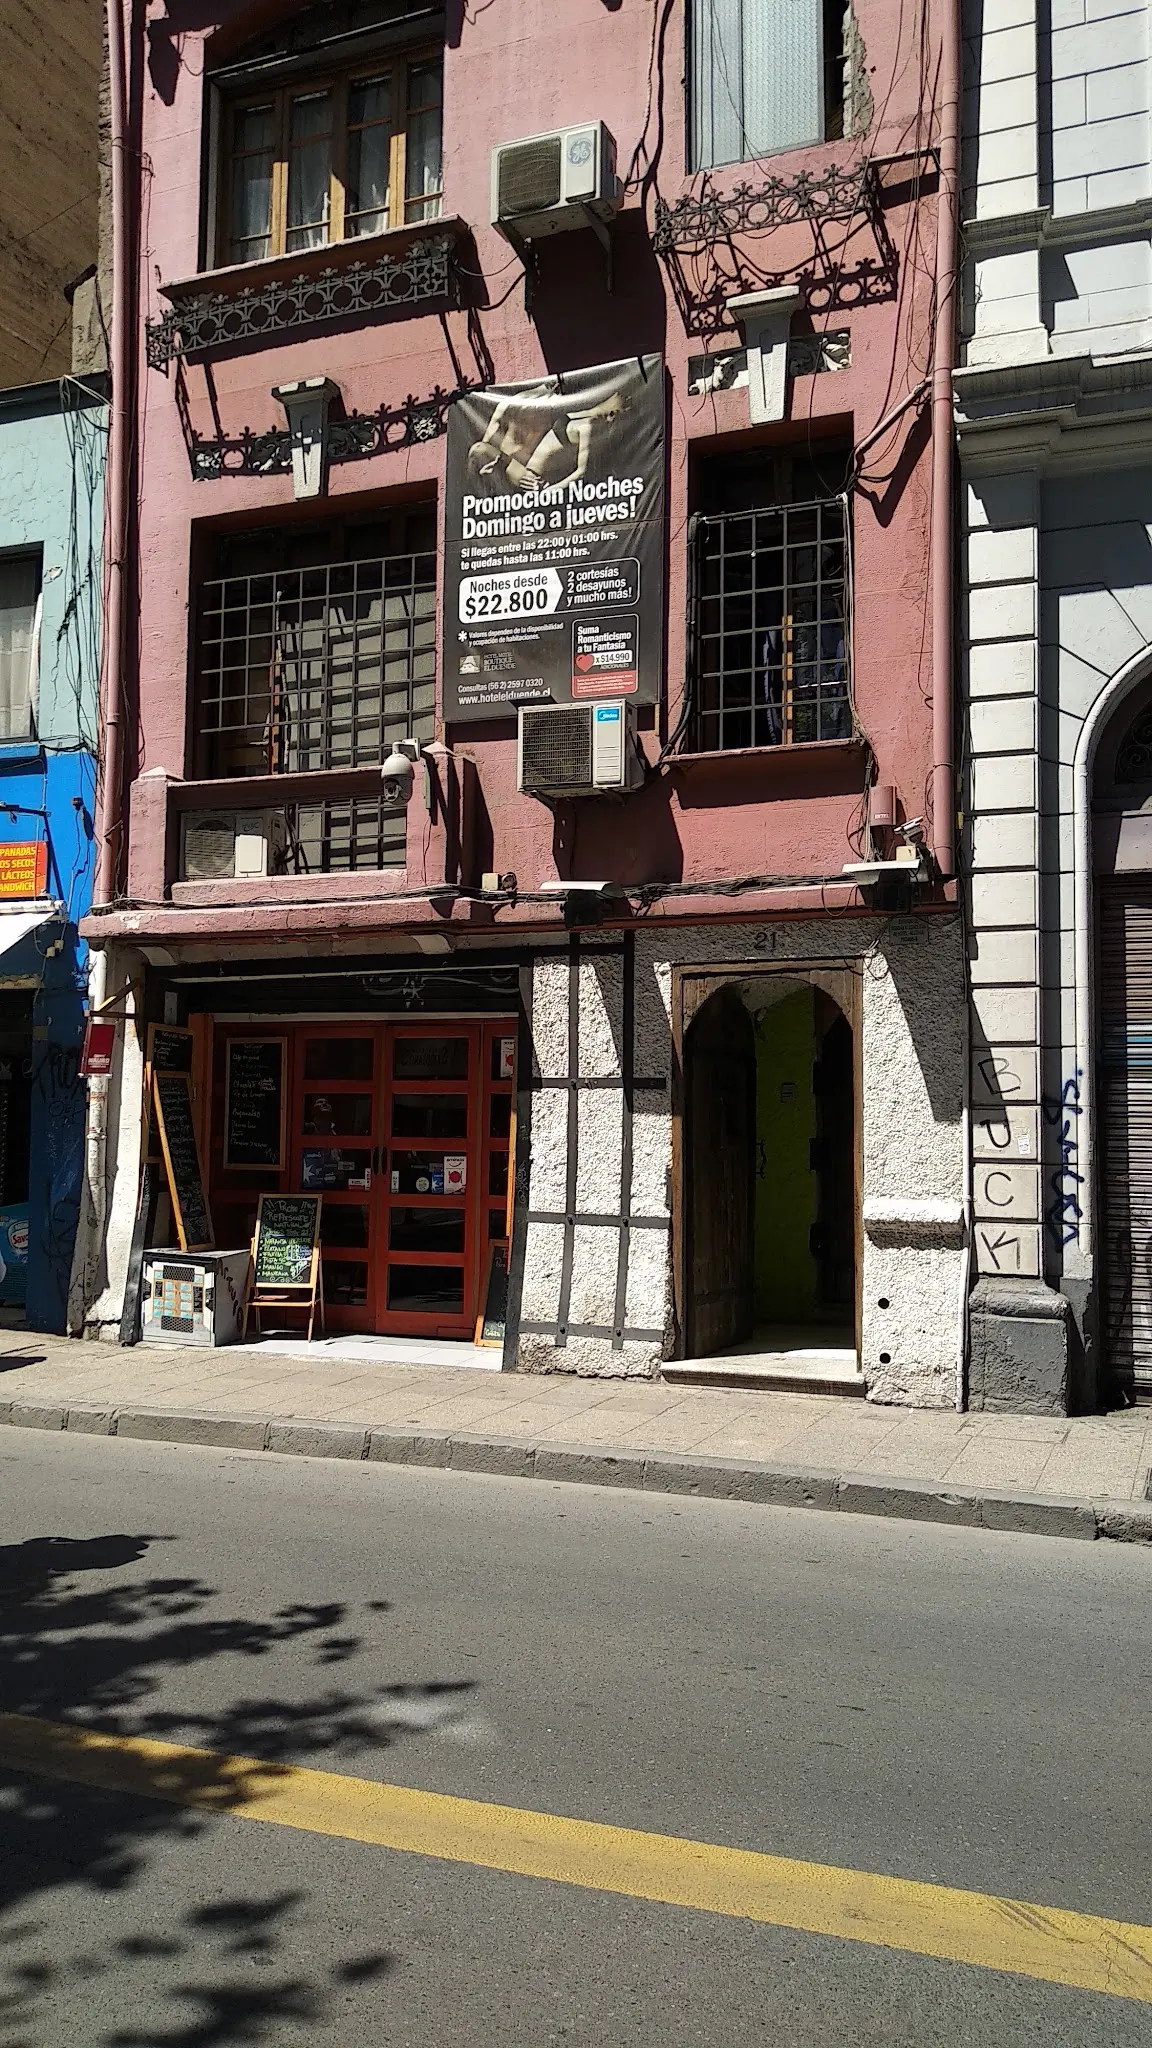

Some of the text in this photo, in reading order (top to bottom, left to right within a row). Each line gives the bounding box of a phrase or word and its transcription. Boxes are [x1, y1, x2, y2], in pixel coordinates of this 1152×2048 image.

[463, 476, 644, 517] Promoción Noches
[462, 496, 636, 539] Domingo a jueves!
[461, 530, 618, 558] Si llegas entre las 22:00 y 01:00 hrs.
[461, 546, 590, 571] te quedas hasta las 11:00 hrs.
[567, 566, 619, 582] 2 cortesías
[470, 573, 548, 593] Noches desde
[567, 577, 626, 593] 2 desayunos
[465, 588, 548, 619] $22.800
[567, 587, 632, 607] y mucho más!
[577, 626, 599, 635] Suma
[577, 632, 632, 644] Romanticismo
[577, 639, 626, 653] a tu Fantasía
[484, 656, 514, 666] BOUTIQUE
[458, 683, 487, 693] Consultas
[488, 681, 499, 691] (56
[507, 679, 524, 689] 2597
[525, 677, 544, 687] 0320
[11, 858, 35, 868] SECOS
[2, 870, 35, 880] LÁCTEOS
[754, 931, 776, 949] 21
